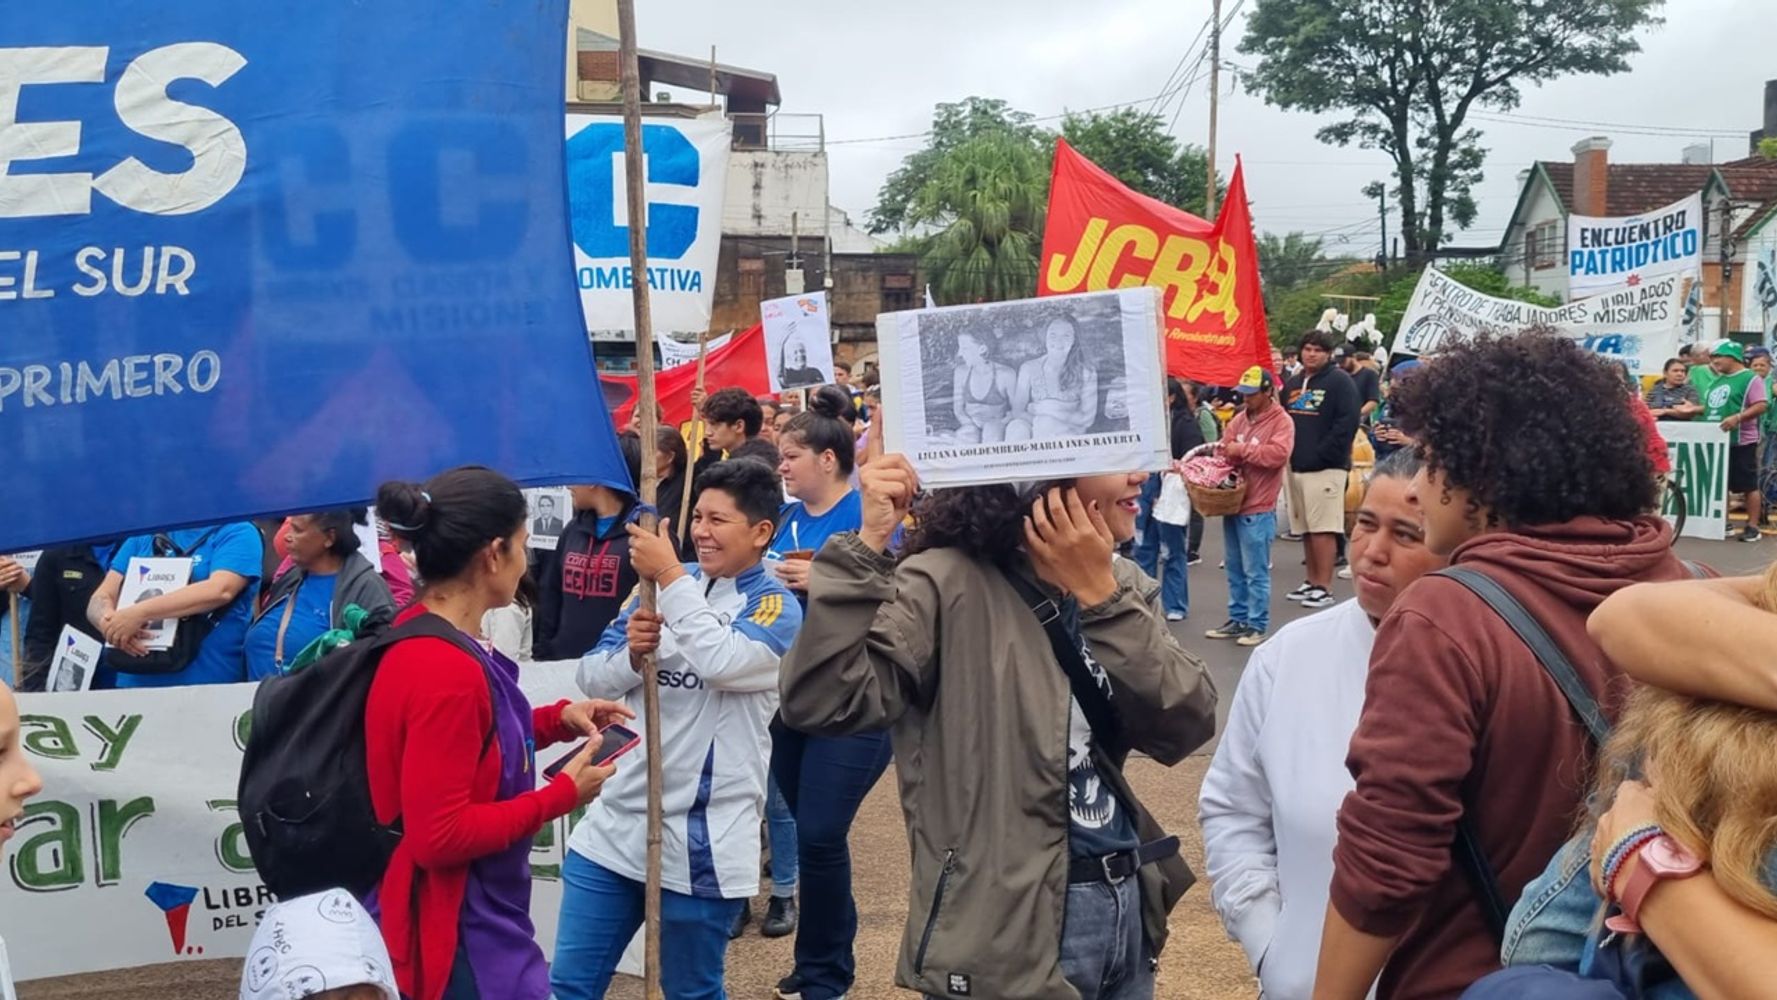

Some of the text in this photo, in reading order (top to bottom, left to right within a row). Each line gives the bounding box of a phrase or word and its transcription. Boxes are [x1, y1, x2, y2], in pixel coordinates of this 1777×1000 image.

[1580, 209, 1687, 249] ENCUENTRO
[72, 245, 196, 297] SUR
[1570, 228, 1697, 276] PATRIOTICO
[1420, 288, 1432, 307] Y
[1593, 300, 1668, 324] MISIONES
[0, 350, 221, 413] PRIMERO
[917, 449, 958, 461] LILIANA
[1066, 437, 1091, 449] INES
[1092, 433, 1141, 446] RAVERTA
[212, 914, 248, 932] DEL
